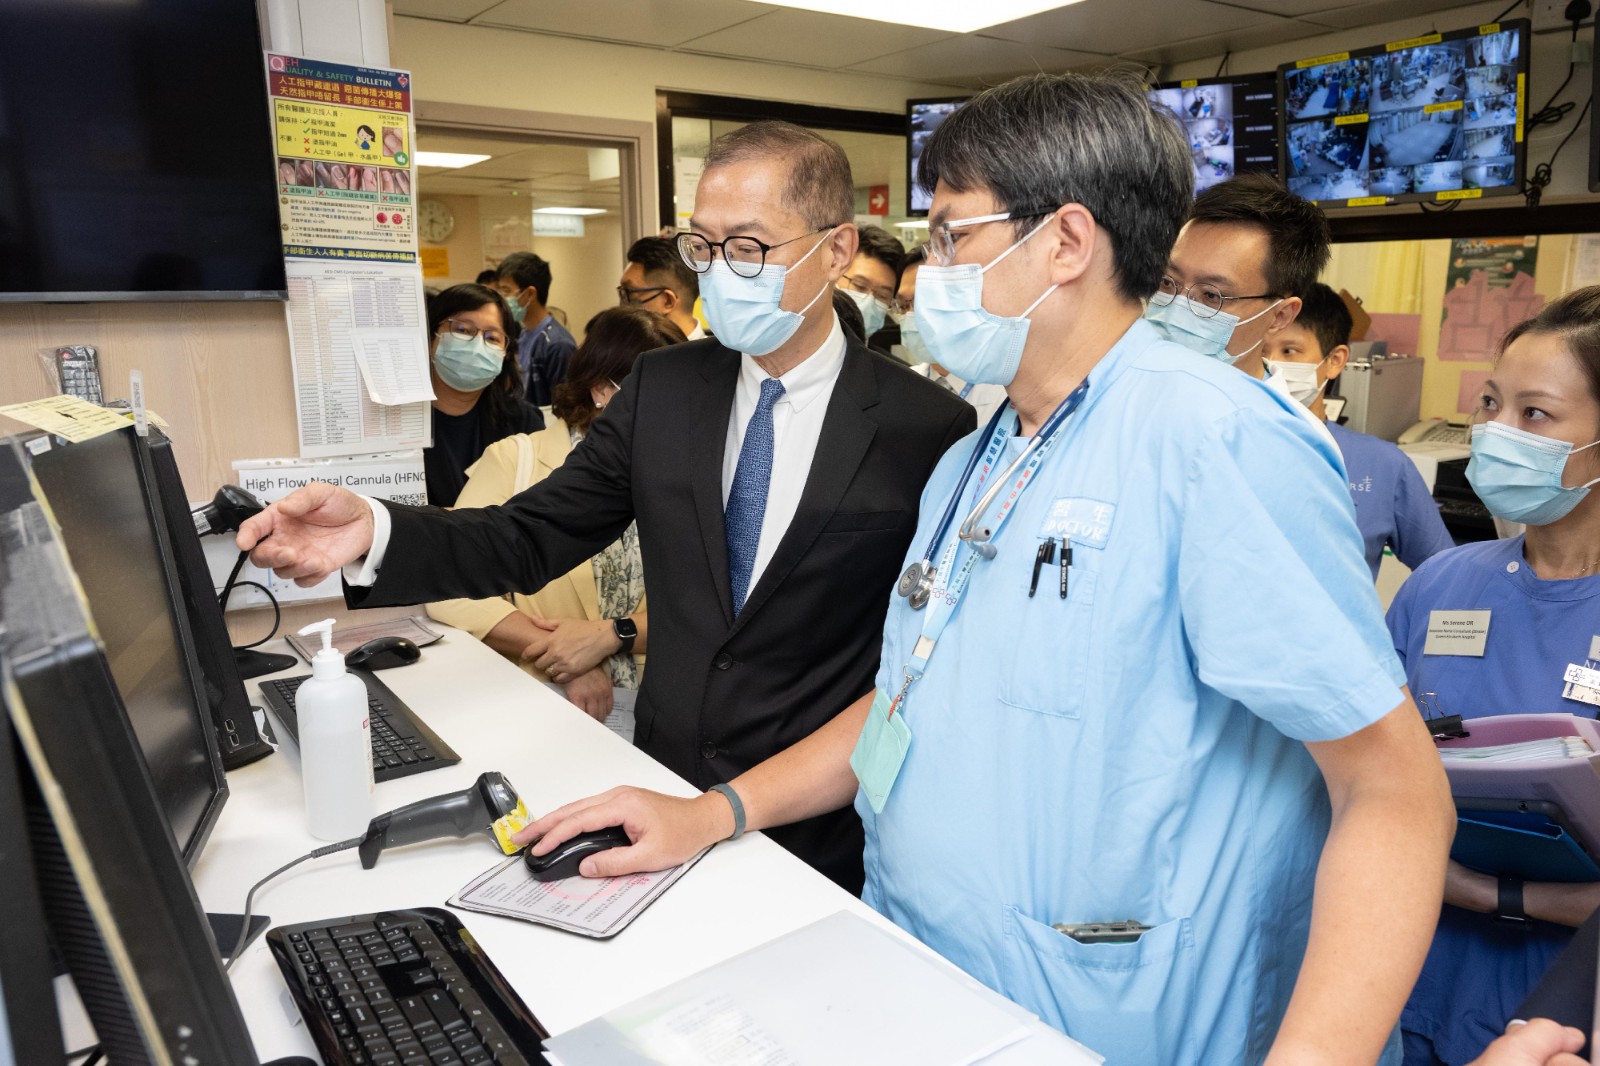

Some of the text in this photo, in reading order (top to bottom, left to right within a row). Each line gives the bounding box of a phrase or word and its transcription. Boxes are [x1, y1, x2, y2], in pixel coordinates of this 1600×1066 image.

[316, 70, 323, 78] &
[326, 72, 353, 82] SAFETY
[356, 76, 391, 87] BULLETIN
[245, 478, 275, 492] High
[278, 476, 307, 490] Flow
[345, 474, 391, 486] Cannula
[1044, 519, 1106, 541] DOCTOR
